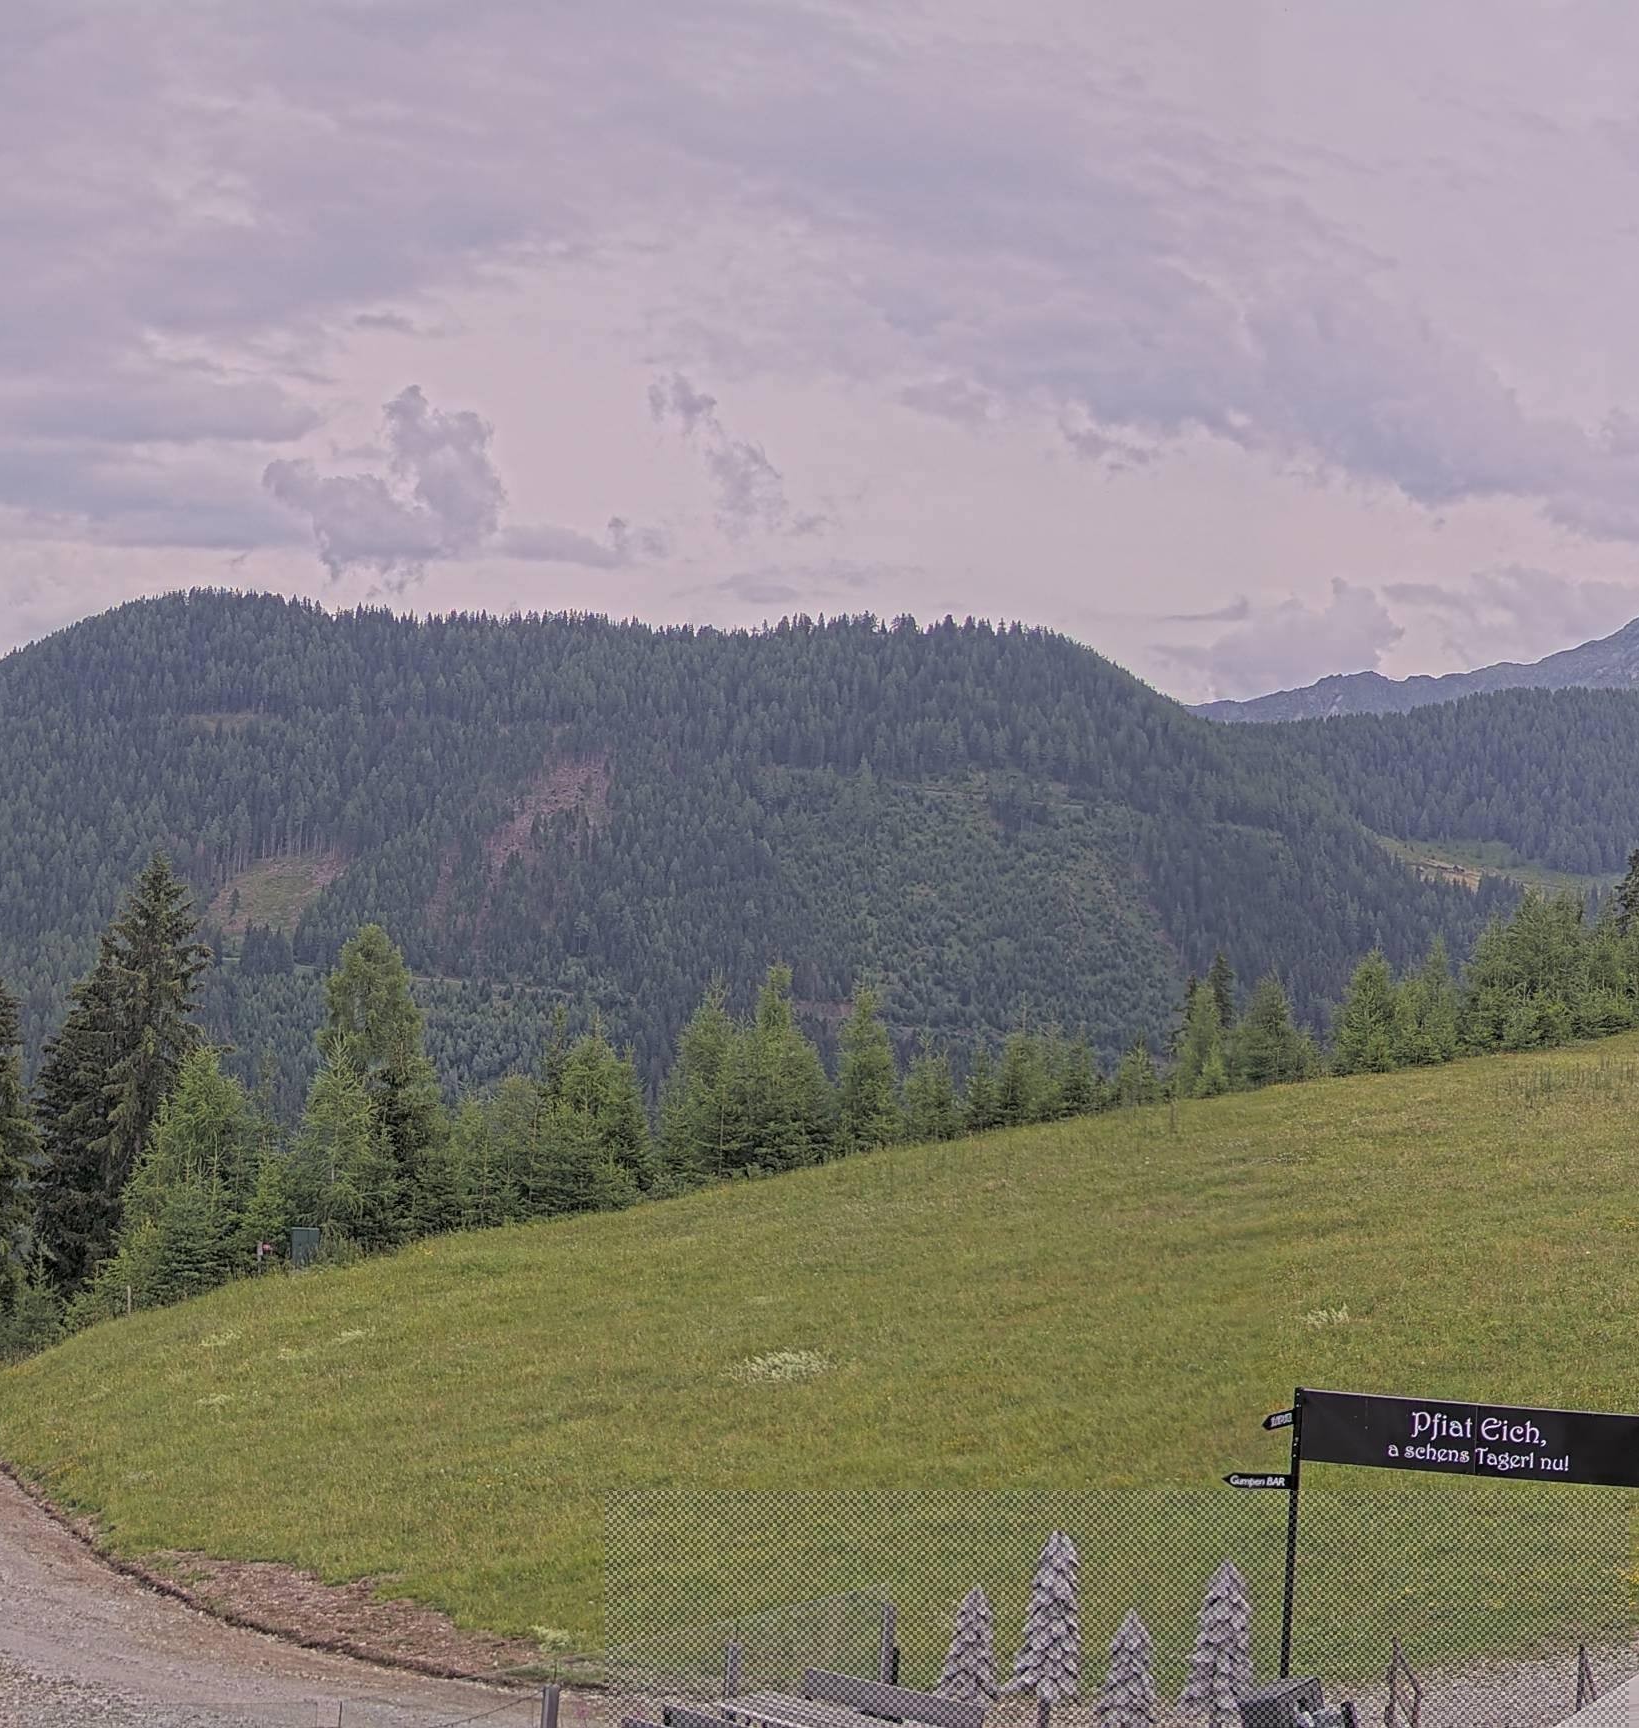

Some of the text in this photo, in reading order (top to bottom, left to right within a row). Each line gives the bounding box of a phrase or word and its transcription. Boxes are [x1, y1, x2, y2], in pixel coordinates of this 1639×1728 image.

[1411, 1411, 1547, 1447] Pfiat Eich,
[1388, 1443, 1569, 1472] a schens Tagerl nu!
[1266, 1476, 1285, 1487] BAR
